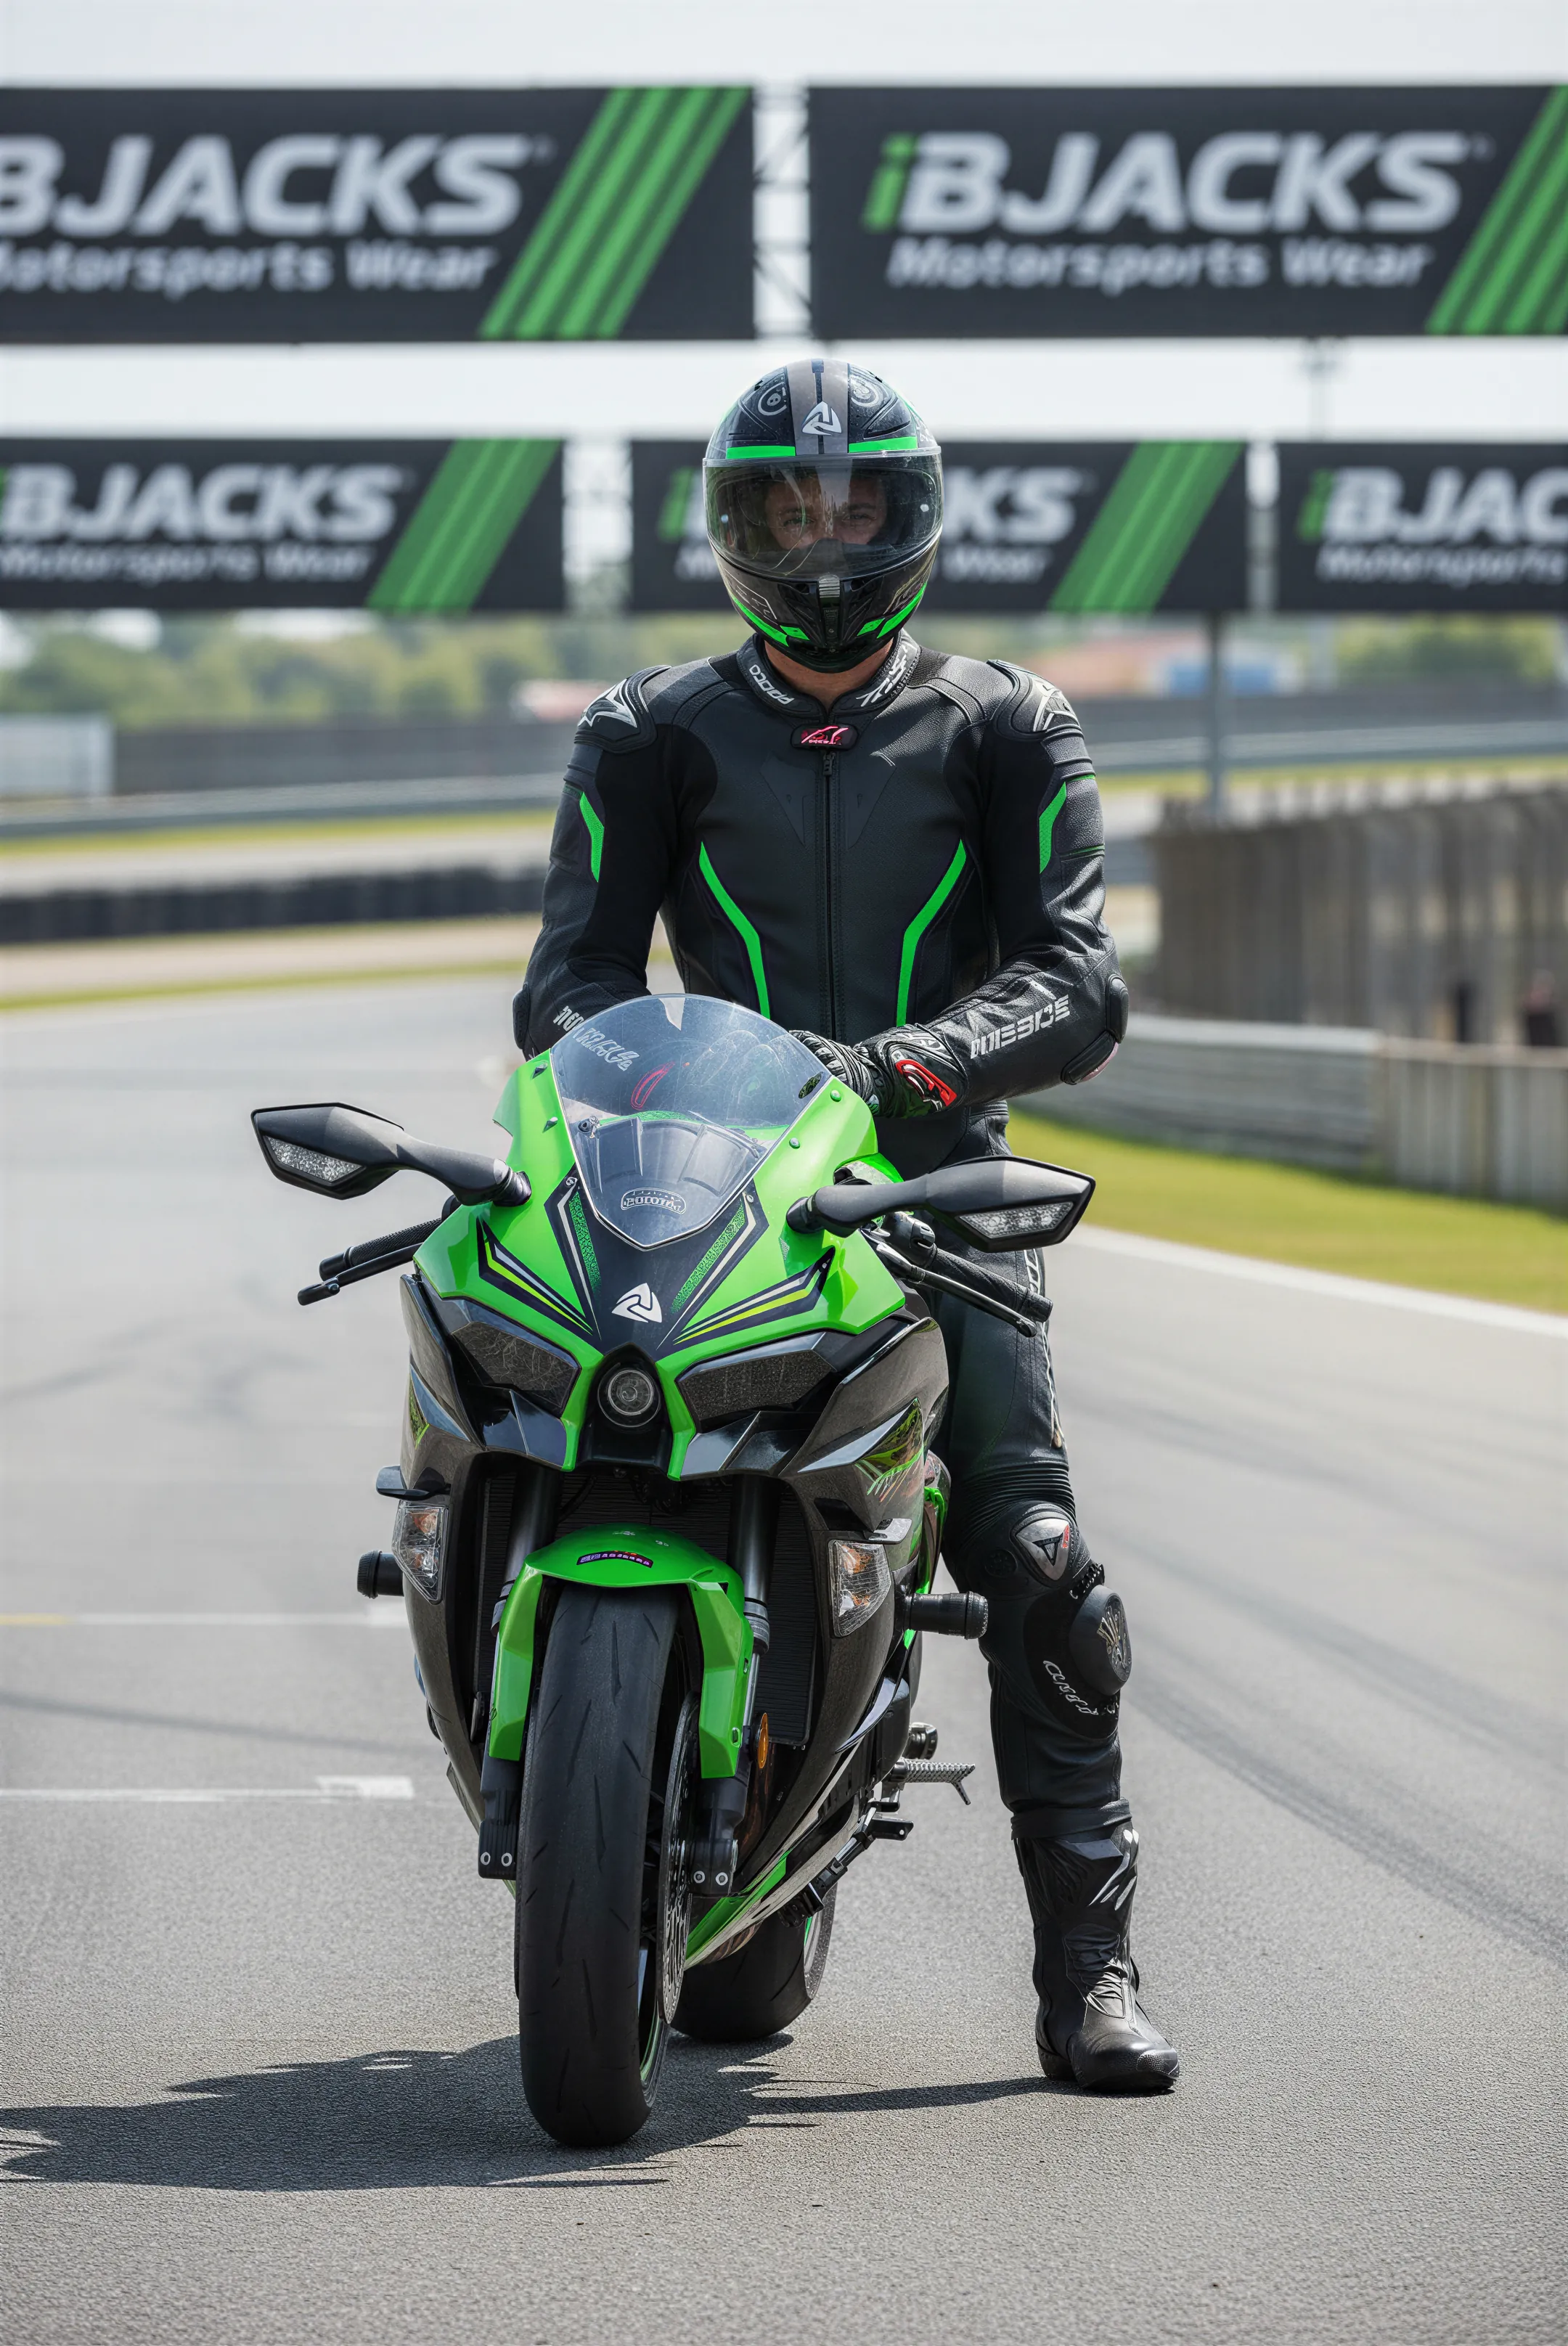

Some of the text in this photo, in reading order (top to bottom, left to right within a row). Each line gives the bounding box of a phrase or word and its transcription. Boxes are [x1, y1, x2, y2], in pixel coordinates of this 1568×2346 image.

[865, 132, 1465, 233] iBJACKS
[344, 241, 498, 292] Wear
[887, 236, 1432, 295] Motorsports Wear
[0, 463, 401, 541] BJACKS
